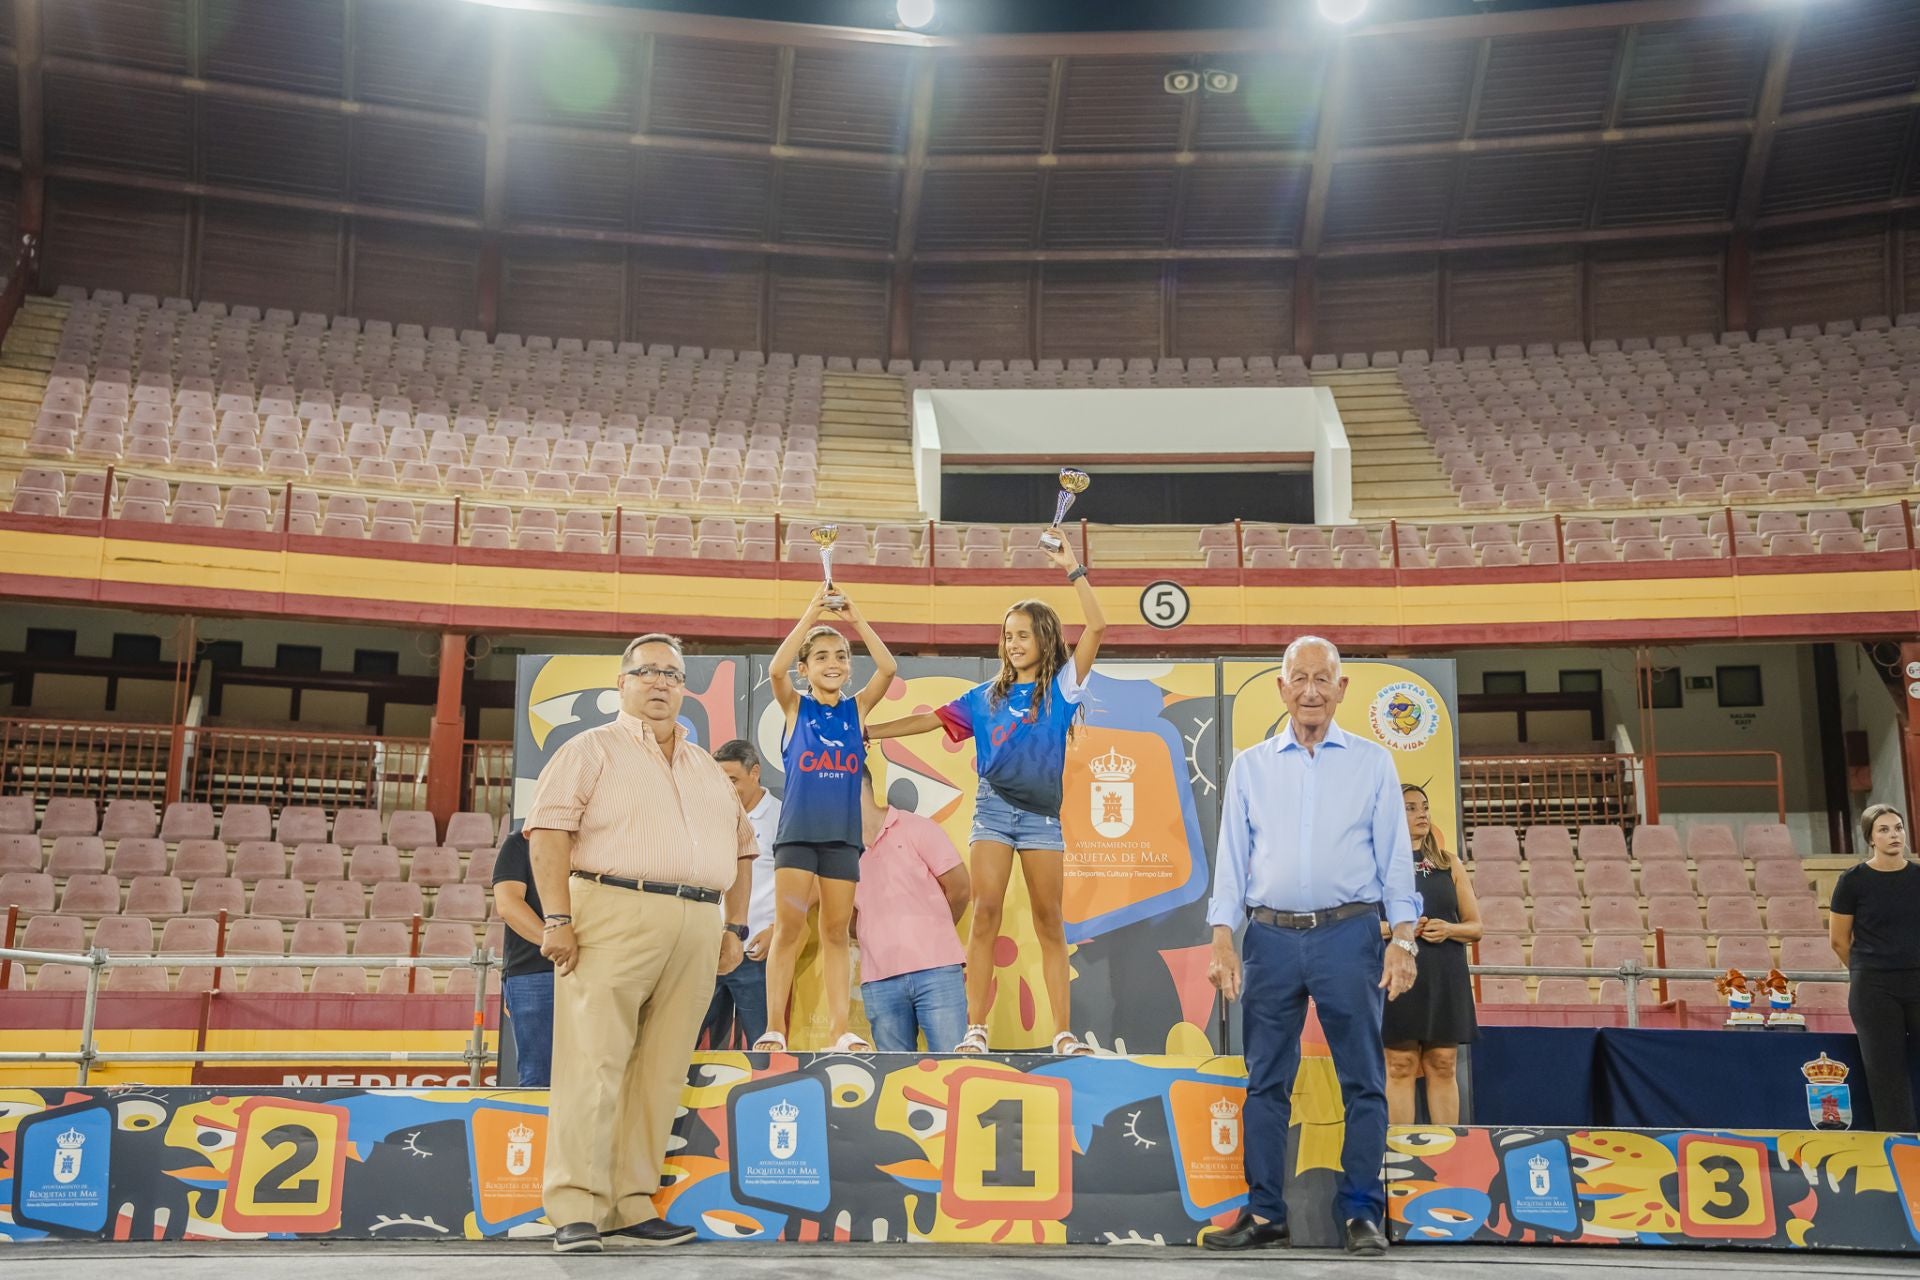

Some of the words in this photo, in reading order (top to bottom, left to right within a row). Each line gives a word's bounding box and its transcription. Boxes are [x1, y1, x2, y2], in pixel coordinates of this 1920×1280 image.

[1156, 591, 1176, 620] 5
[1387, 740, 1398, 749] LA
[1403, 742, 1424, 750] VIDA
[799, 750, 858, 774] GALO
[1121, 853, 1136, 862] DE
[1141, 851, 1168, 862] MAR
[282, 1074, 497, 1087] MEDICO
[976, 1099, 1036, 1187] 1
[252, 1124, 320, 1204] 2
[747, 1166, 784, 1175] ROQUETAS
[29, 1190, 66, 1199] ROQUETAS
[1700, 1154, 1750, 1219] 3
